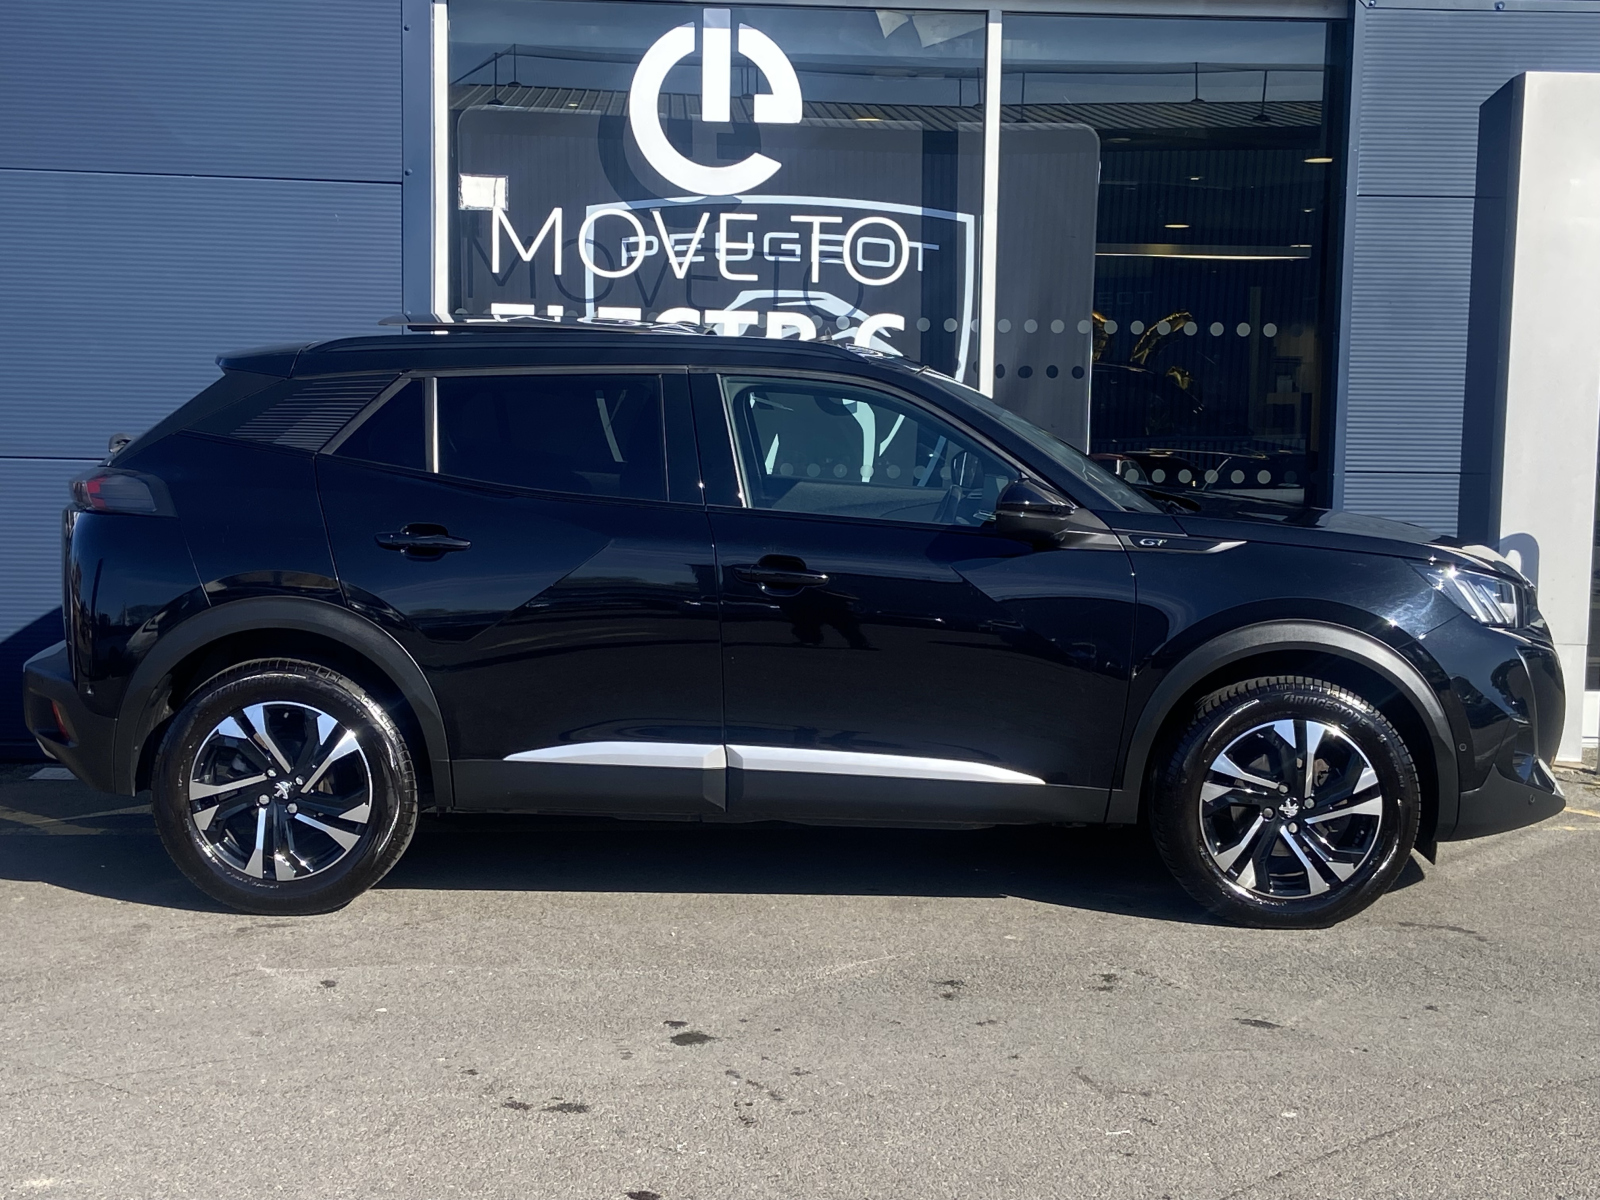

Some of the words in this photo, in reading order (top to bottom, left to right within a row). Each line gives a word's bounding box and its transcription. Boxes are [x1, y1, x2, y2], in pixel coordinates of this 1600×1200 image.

[491, 205, 758, 281] MOVE
[790, 215, 910, 286] TO
[621, 231, 940, 272] PEUGEOT
[1139, 537, 1168, 547] GT
